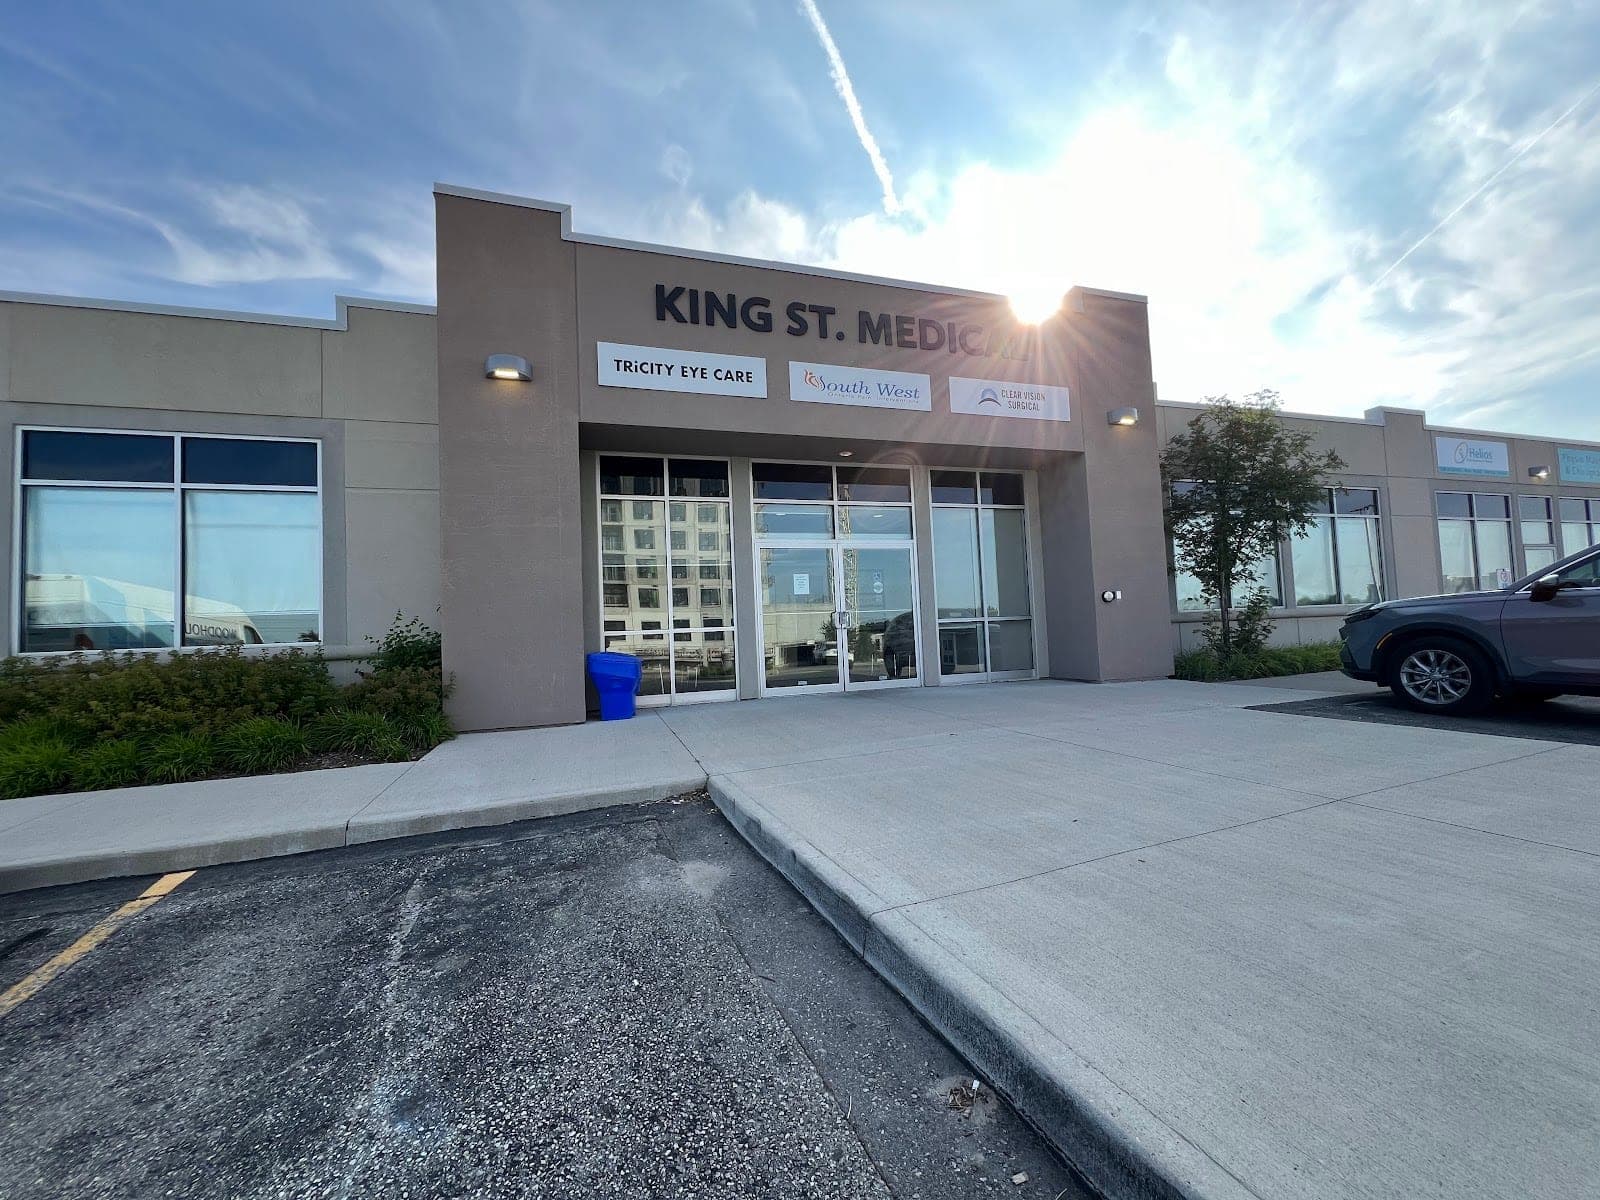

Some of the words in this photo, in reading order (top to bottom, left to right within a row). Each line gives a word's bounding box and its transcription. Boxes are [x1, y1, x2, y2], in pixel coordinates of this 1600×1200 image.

[655, 284, 773, 333] KING
[786, 301, 846, 341] ST.
[613, 359, 675, 377] TRiCITY
[680, 365, 708, 380] EYE
[713, 368, 753, 383] CARE
[819, 375, 871, 395] South
[876, 382, 920, 400] West
[1001, 389, 1022, 400] CLEAR
[1023, 391, 1047, 401] VISION
[1008, 400, 1041, 411] SURGICAL
